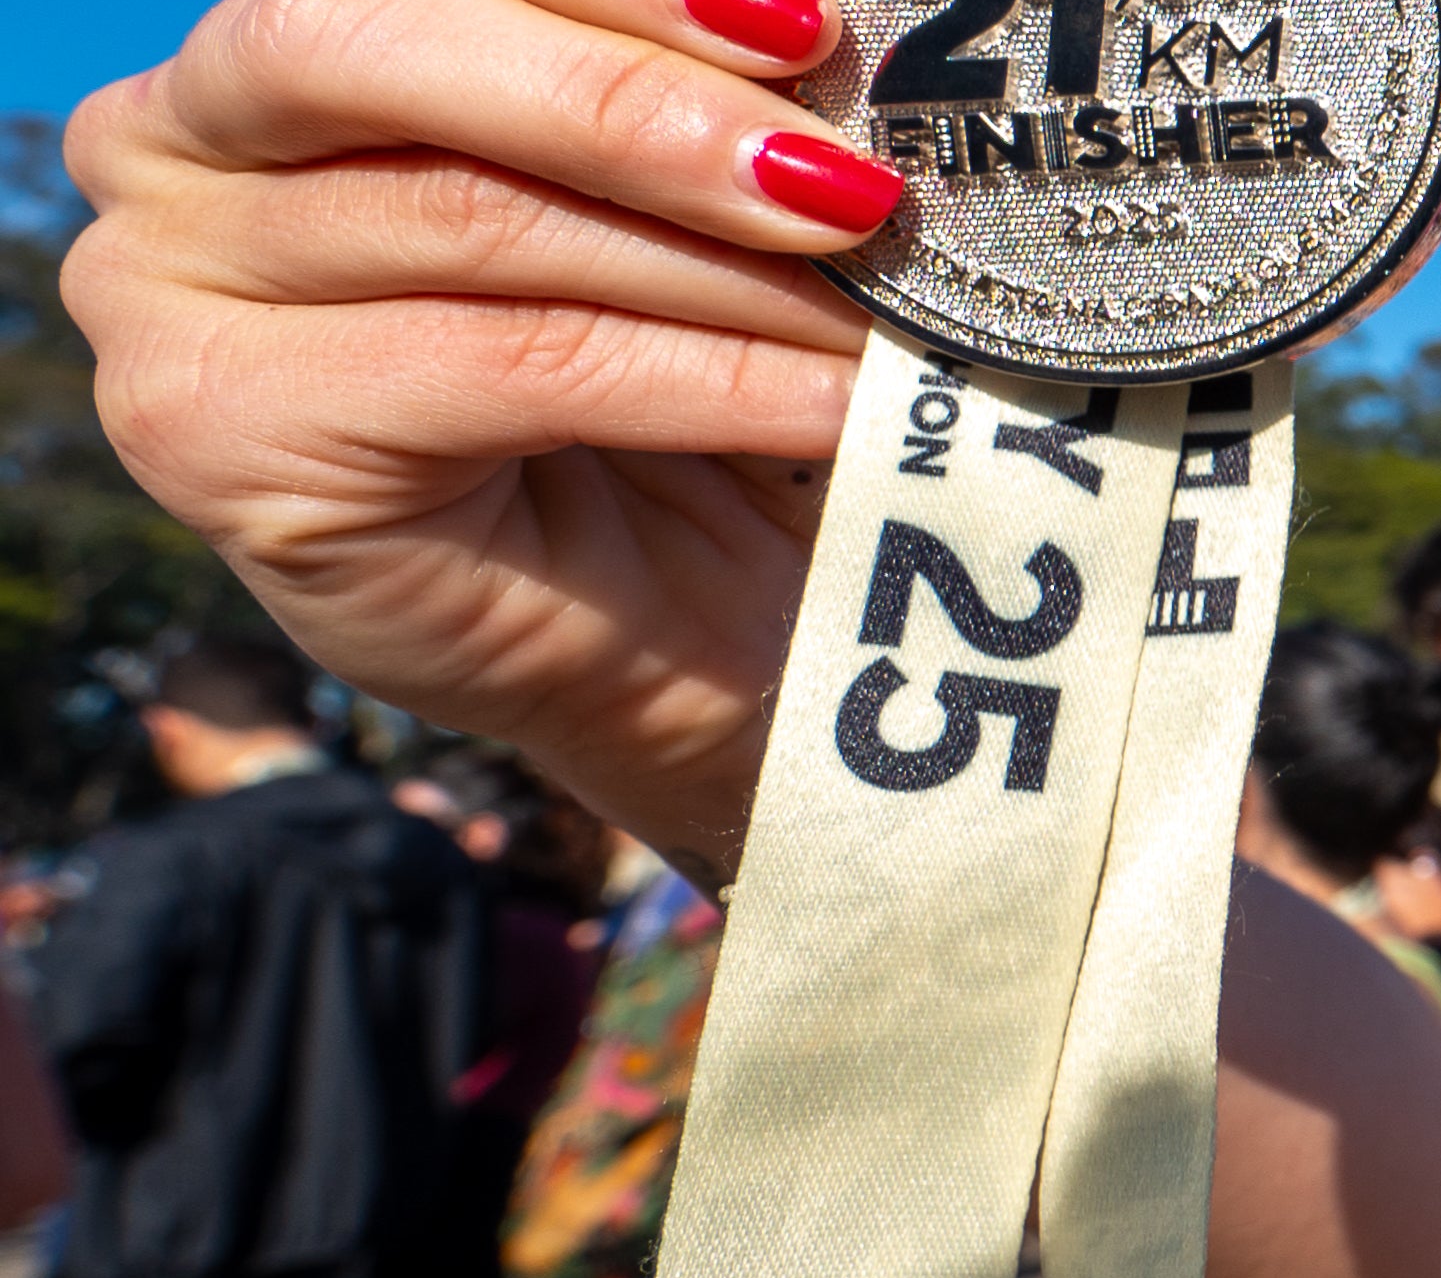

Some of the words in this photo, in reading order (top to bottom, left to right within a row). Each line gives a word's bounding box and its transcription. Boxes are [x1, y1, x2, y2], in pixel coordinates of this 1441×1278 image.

[1137, 18, 1284, 89] KM
[870, 97, 1338, 175] FINISHER
[834, 519, 1083, 794] 25
